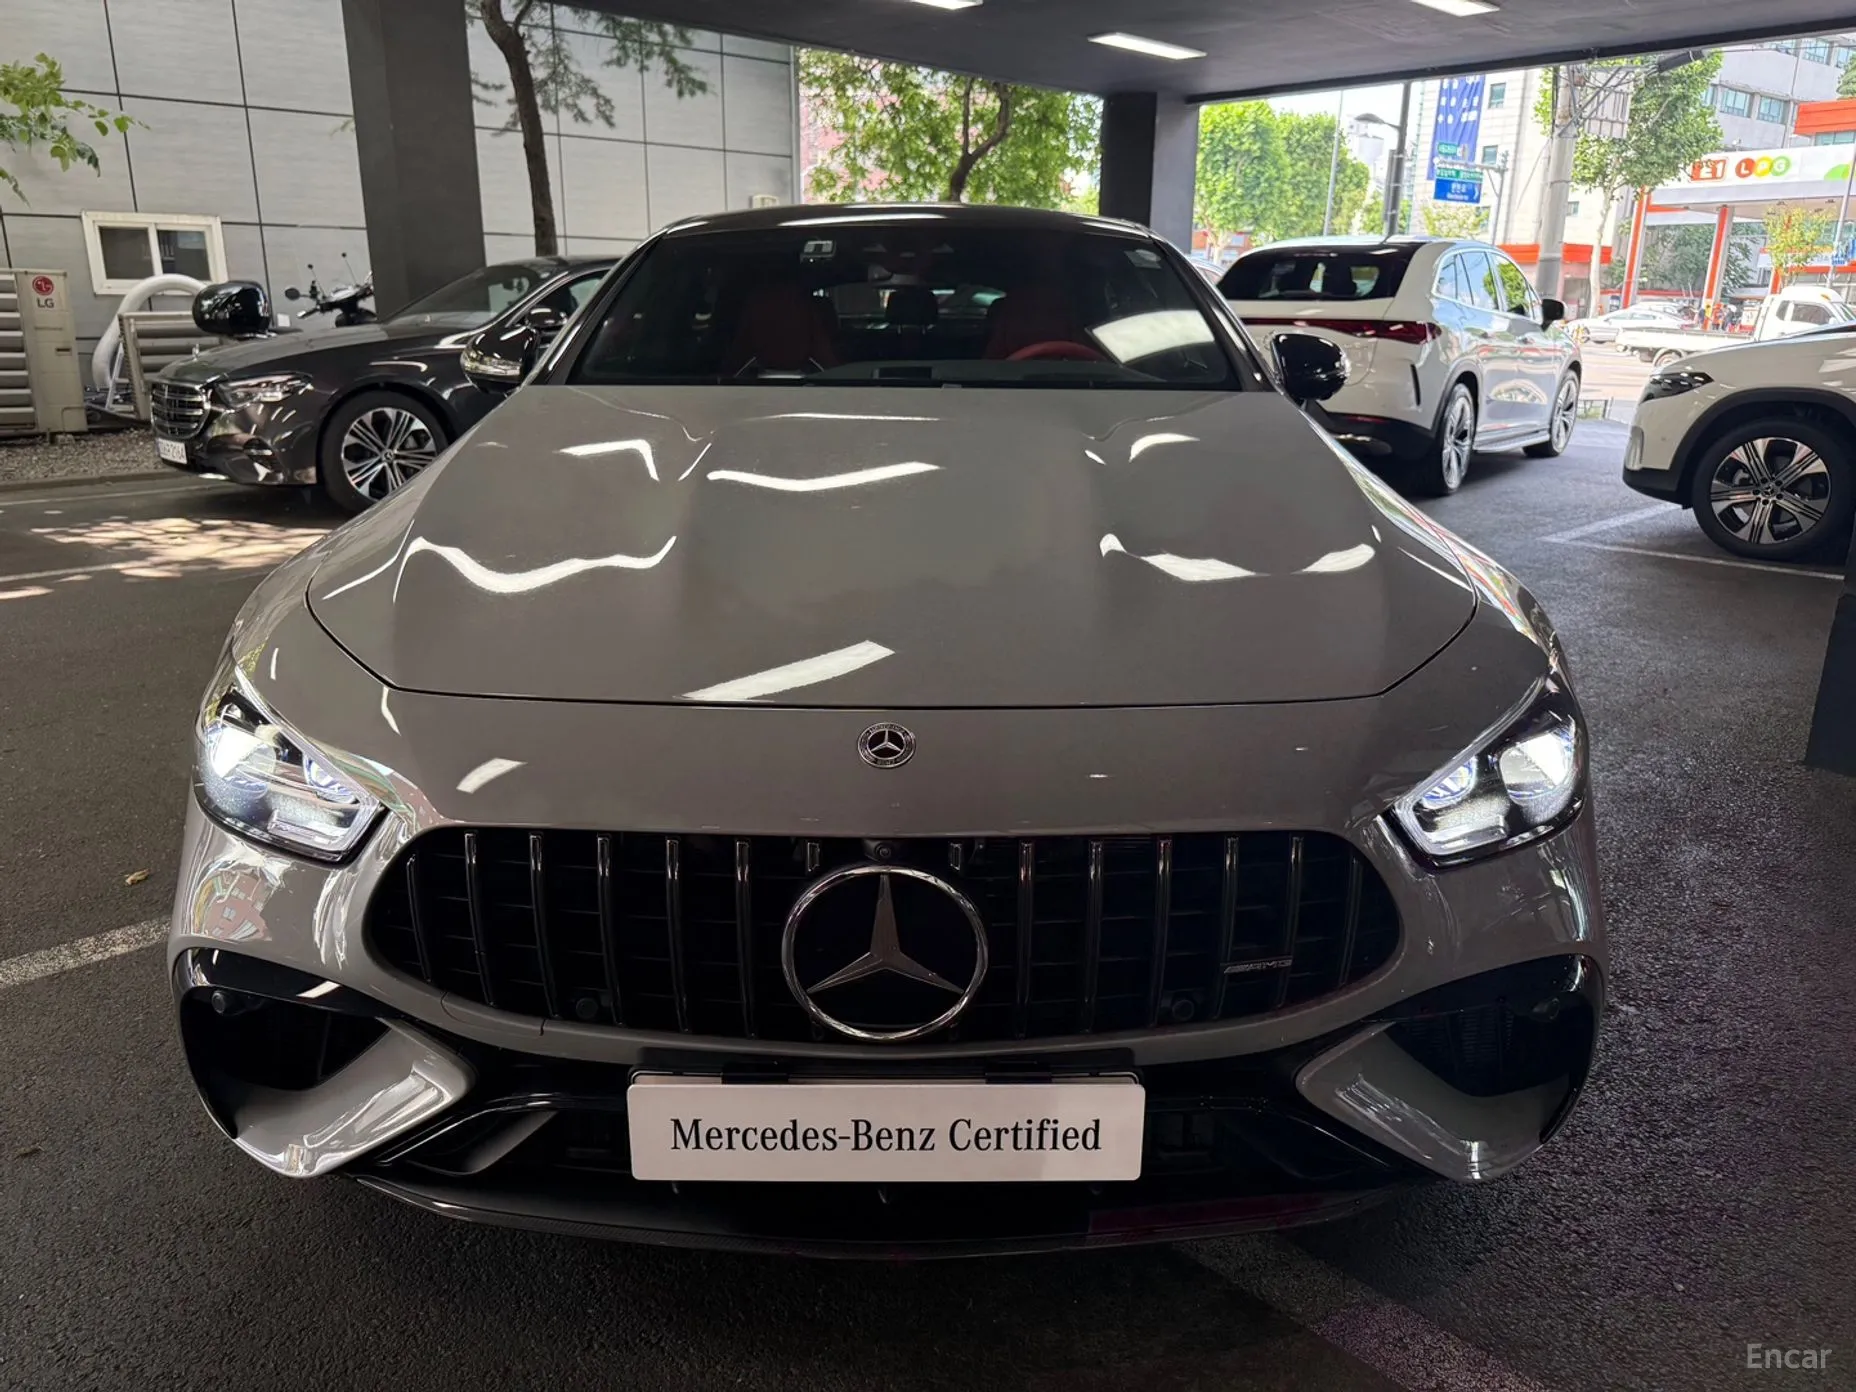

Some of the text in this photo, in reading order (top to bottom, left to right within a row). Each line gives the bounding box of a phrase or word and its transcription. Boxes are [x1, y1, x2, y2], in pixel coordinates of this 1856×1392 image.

[1738, 159, 1788, 175] LPG
[36, 297, 55, 309] LG
[669, 1118, 1102, 1151] Mercedes-Benz Certified
